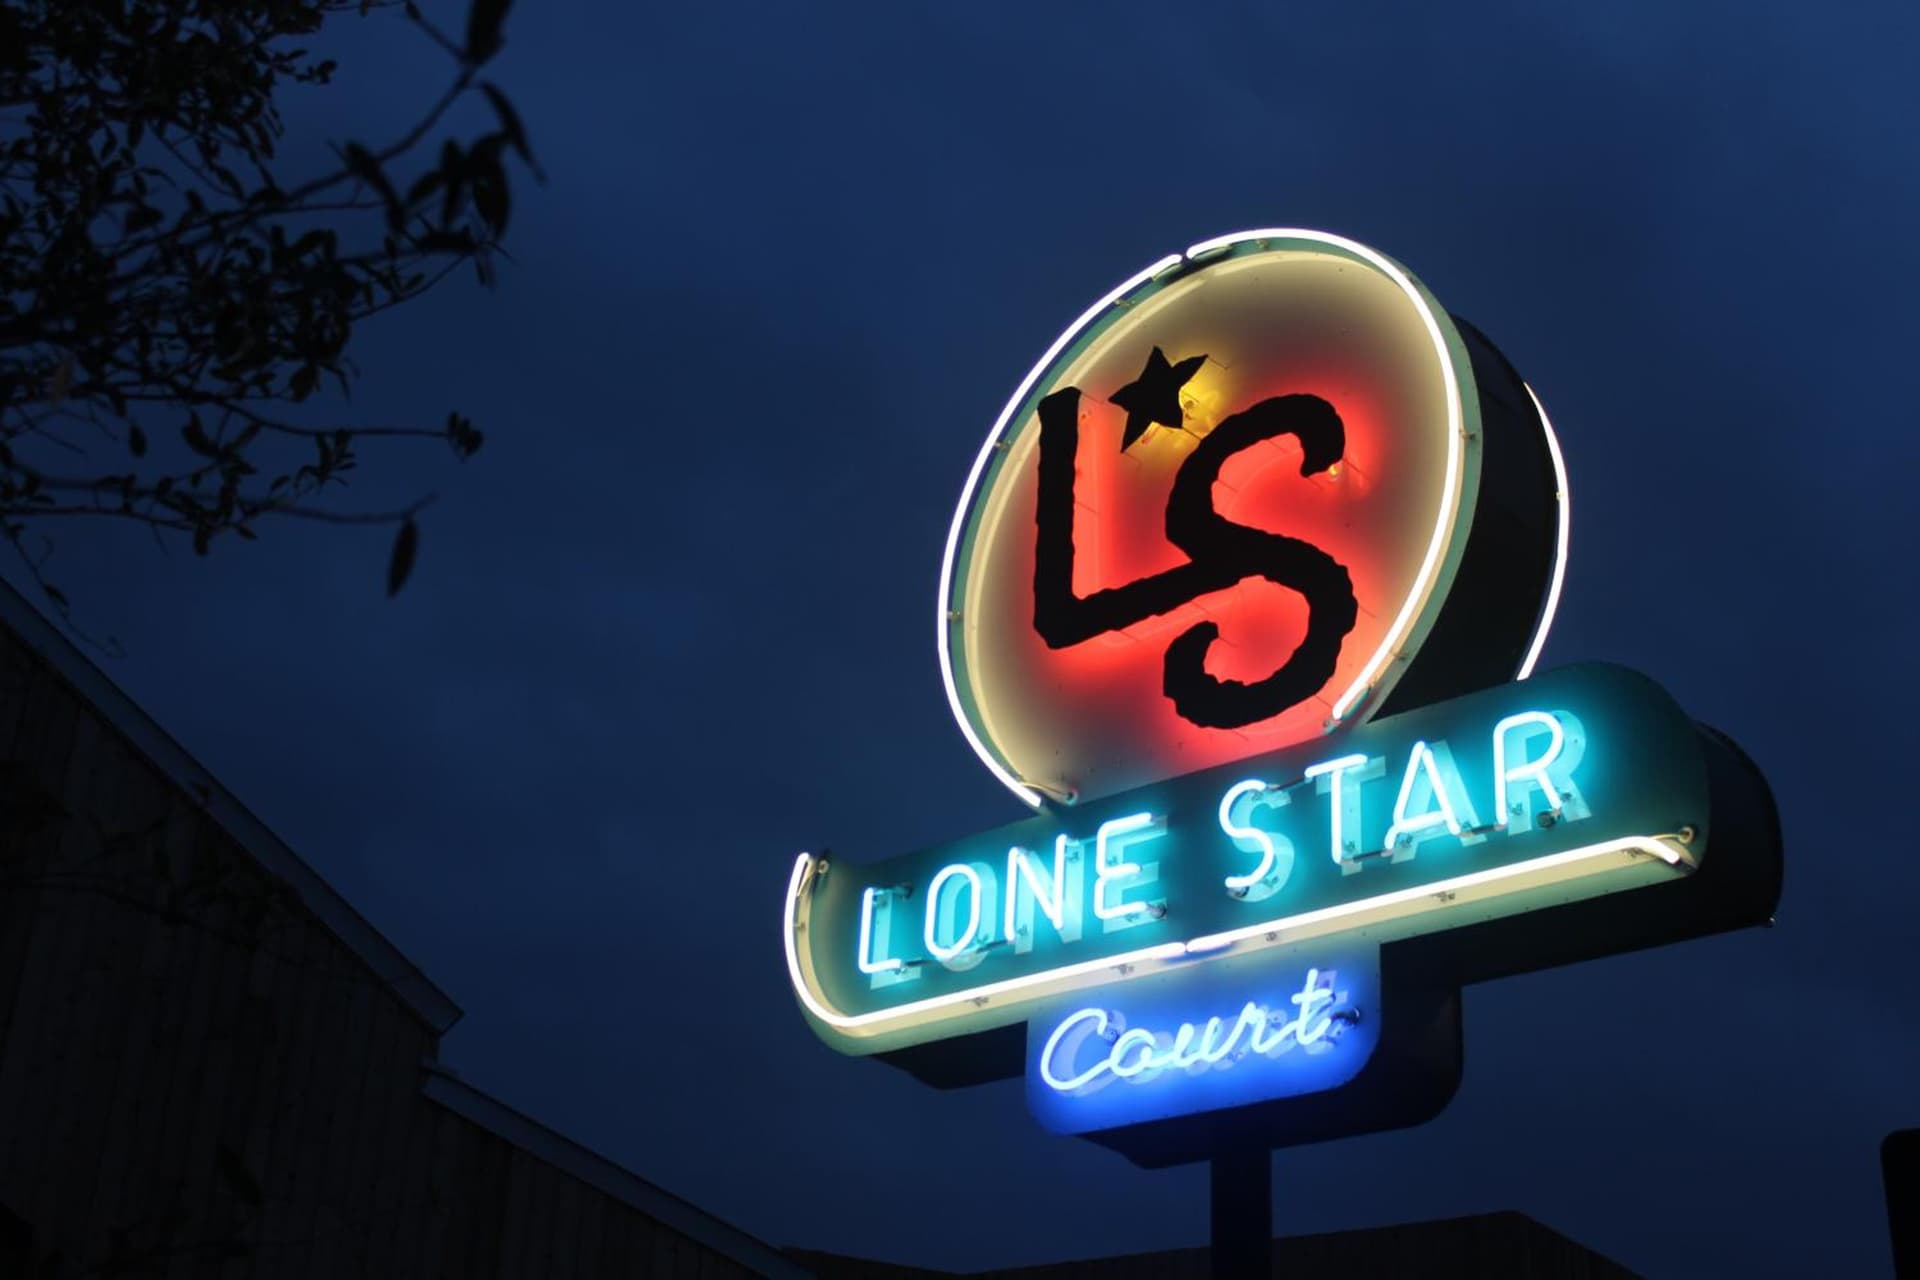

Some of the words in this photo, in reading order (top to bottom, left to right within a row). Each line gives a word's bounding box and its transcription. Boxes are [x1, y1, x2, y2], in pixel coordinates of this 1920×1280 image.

[1033, 386, 1358, 729] LS
[858, 811, 1165, 985] LONE
[1219, 710, 1588, 898] STAR
[1040, 968, 1340, 1092] Court
